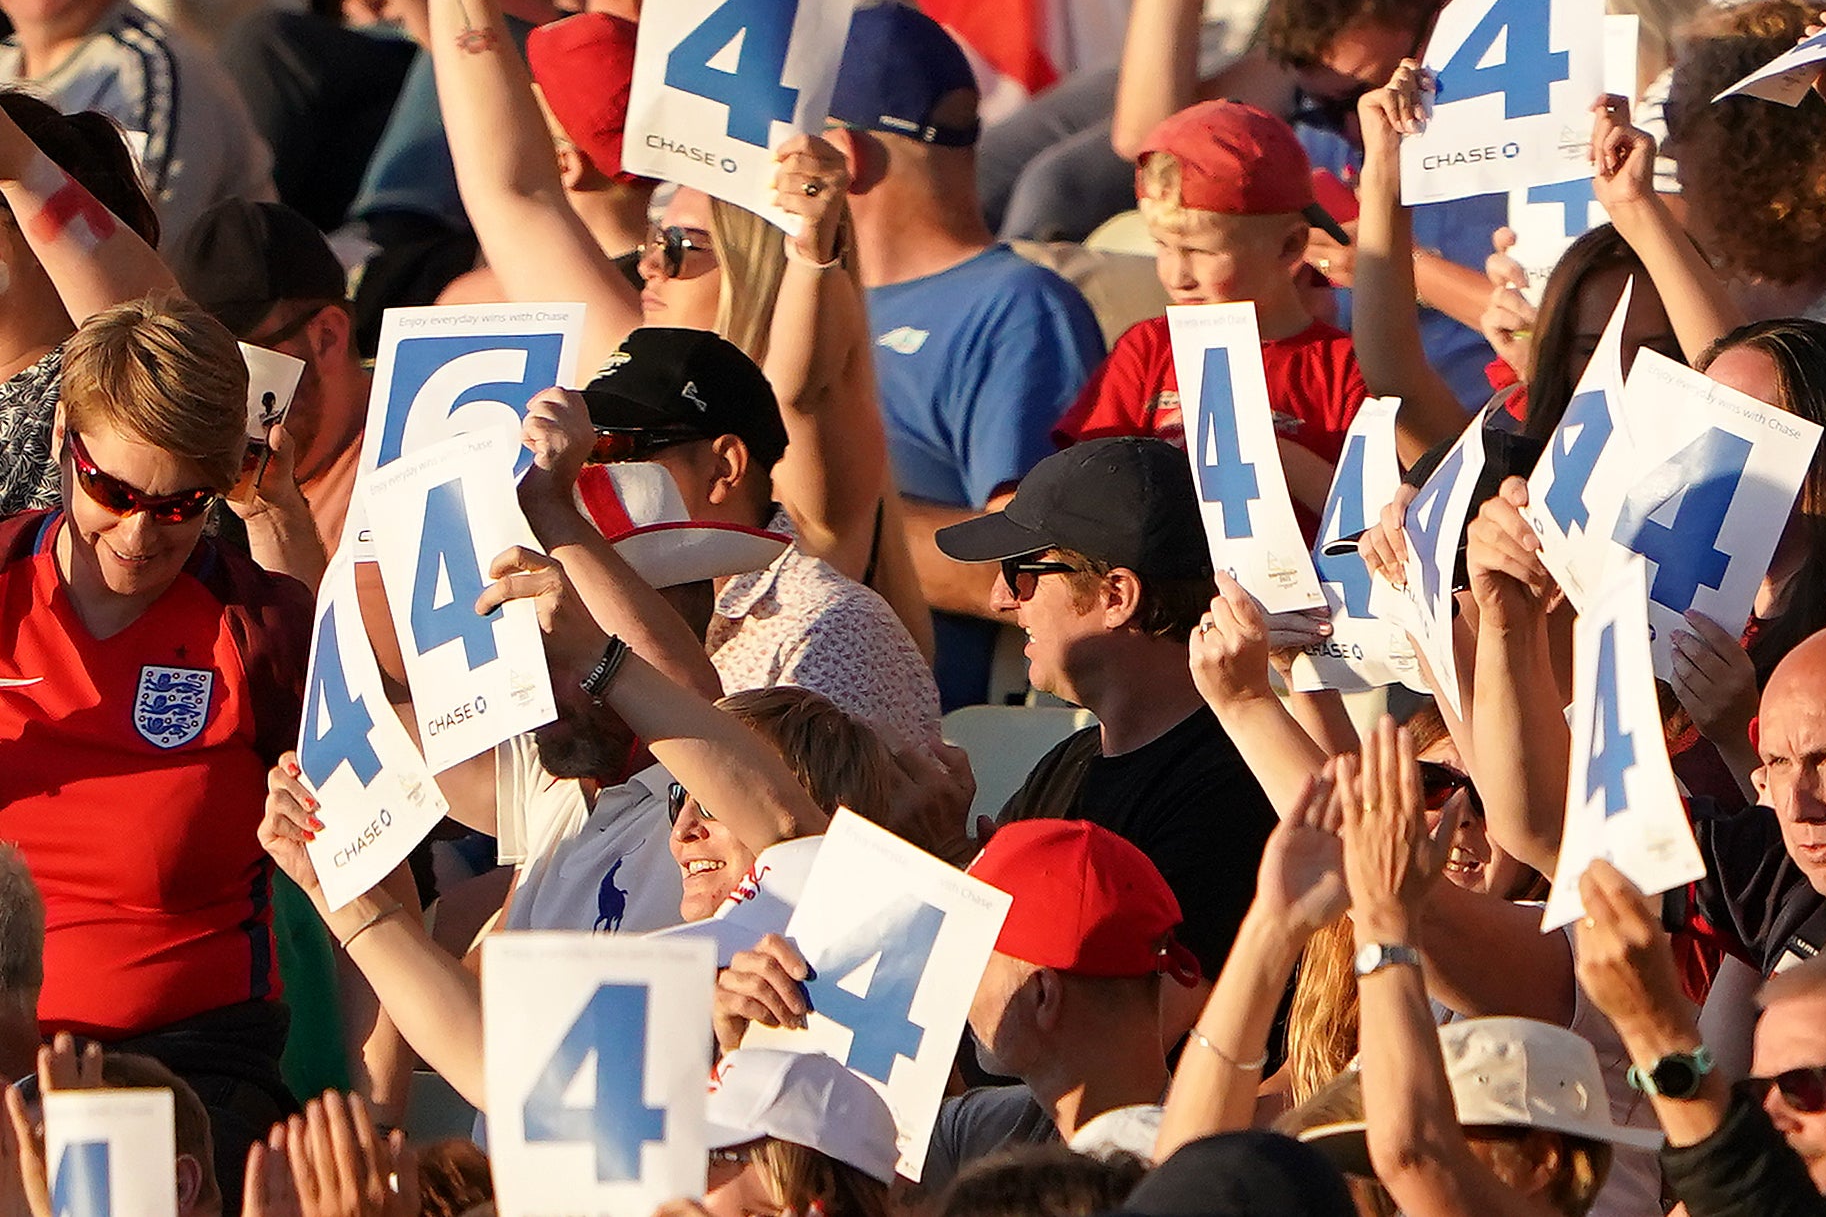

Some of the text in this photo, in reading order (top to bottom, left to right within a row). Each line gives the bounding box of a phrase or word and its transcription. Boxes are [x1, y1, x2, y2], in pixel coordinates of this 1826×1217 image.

[645, 133, 716, 167] CHASE
[1422, 146, 1498, 171] CHASE
[399, 311, 570, 329] Enjoy everyday wins with Chase
[1198, 348, 1259, 537] 4
[1546, 390, 1612, 532] 4
[1717, 398, 1741, 415] wins
[1743, 407, 1766, 426] with
[1767, 417, 1803, 440] Chase
[409, 478, 503, 670] 4
[1312, 436, 1373, 618] 4
[1405, 446, 1464, 620] 4
[1611, 427, 1753, 615] 4
[301, 600, 383, 790] 4
[427, 705, 473, 737] CHASE
[1587, 625, 1634, 815] 4
[333, 822, 381, 869] CHASE
[802, 900, 945, 1085] 4
[524, 982, 667, 1183] 4
